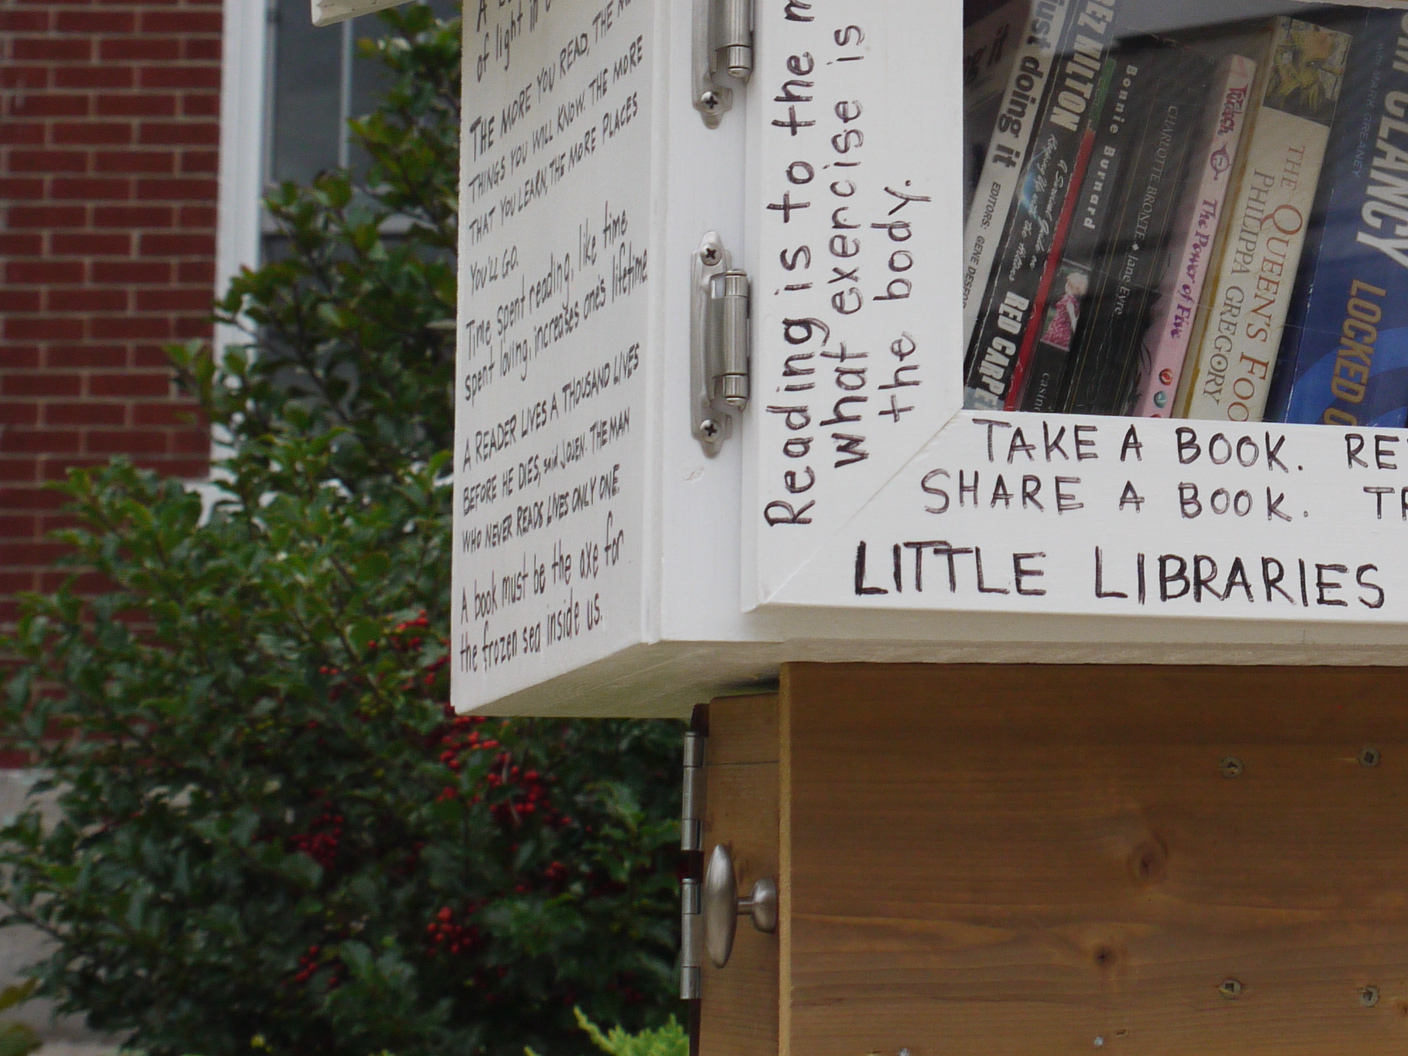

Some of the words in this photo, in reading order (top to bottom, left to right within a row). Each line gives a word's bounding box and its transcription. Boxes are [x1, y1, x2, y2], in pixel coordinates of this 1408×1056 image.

[826, 24, 865, 65] is
[1050, 34, 1104, 132] HILTON
[771, 51, 816, 136] the
[998, 55, 1044, 139] doing
[1109, 64, 1138, 134] Bonnie
[766, 160, 815, 224] to
[992, 144, 1021, 169] it
[1083, 145, 1116, 229] Burnard
[1282, 145, 1305, 188] THE
[822, 100, 865, 315] exercise
[870, 179, 932, 302] body.
[1197, 198, 1217, 226] The
[1230, 168, 1276, 277] PHILIPPA
[774, 245, 813, 295] is
[970, 235, 985, 265] GENE
[1179, 281, 1196, 301] of
[1186, 228, 1209, 283] Power
[1245, 202, 1303, 344] QUEEN'S
[465, 345, 495, 407] spent
[534, 300, 580, 359] increases
[998, 291, 1030, 335] RED
[1202, 285, 1246, 405] GREGORY
[1331, 279, 1386, 404] LOCKED
[819, 341, 870, 468] what
[877, 331, 923, 423] the
[1226, 351, 1269, 422] FOO
[764, 317, 830, 527] Reading
[972, 418, 1099, 464] TAKE
[1120, 423, 1142, 462] A
[1175, 426, 1304, 474] BOOK.
[921, 468, 1084, 515] SHARE
[1118, 480, 1145, 513] A
[1178, 481, 1309, 522] BOOK.
[461, 587, 468, 625] A
[475, 570, 498, 621] book
[502, 552, 528, 607] must
[534, 554, 546, 593] be
[552, 540, 571, 585] the
[580, 541, 599, 579] axe
[605, 510, 624, 566] for
[854, 541, 1047, 595] LITTLE
[1095, 546, 1386, 608] LIBRARIES
[460, 632, 477, 673] the
[482, 620, 517, 673] frozen
[523, 623, 540, 654] sea
[546, 588, 580, 647] inside
[587, 593, 603, 630] us.
